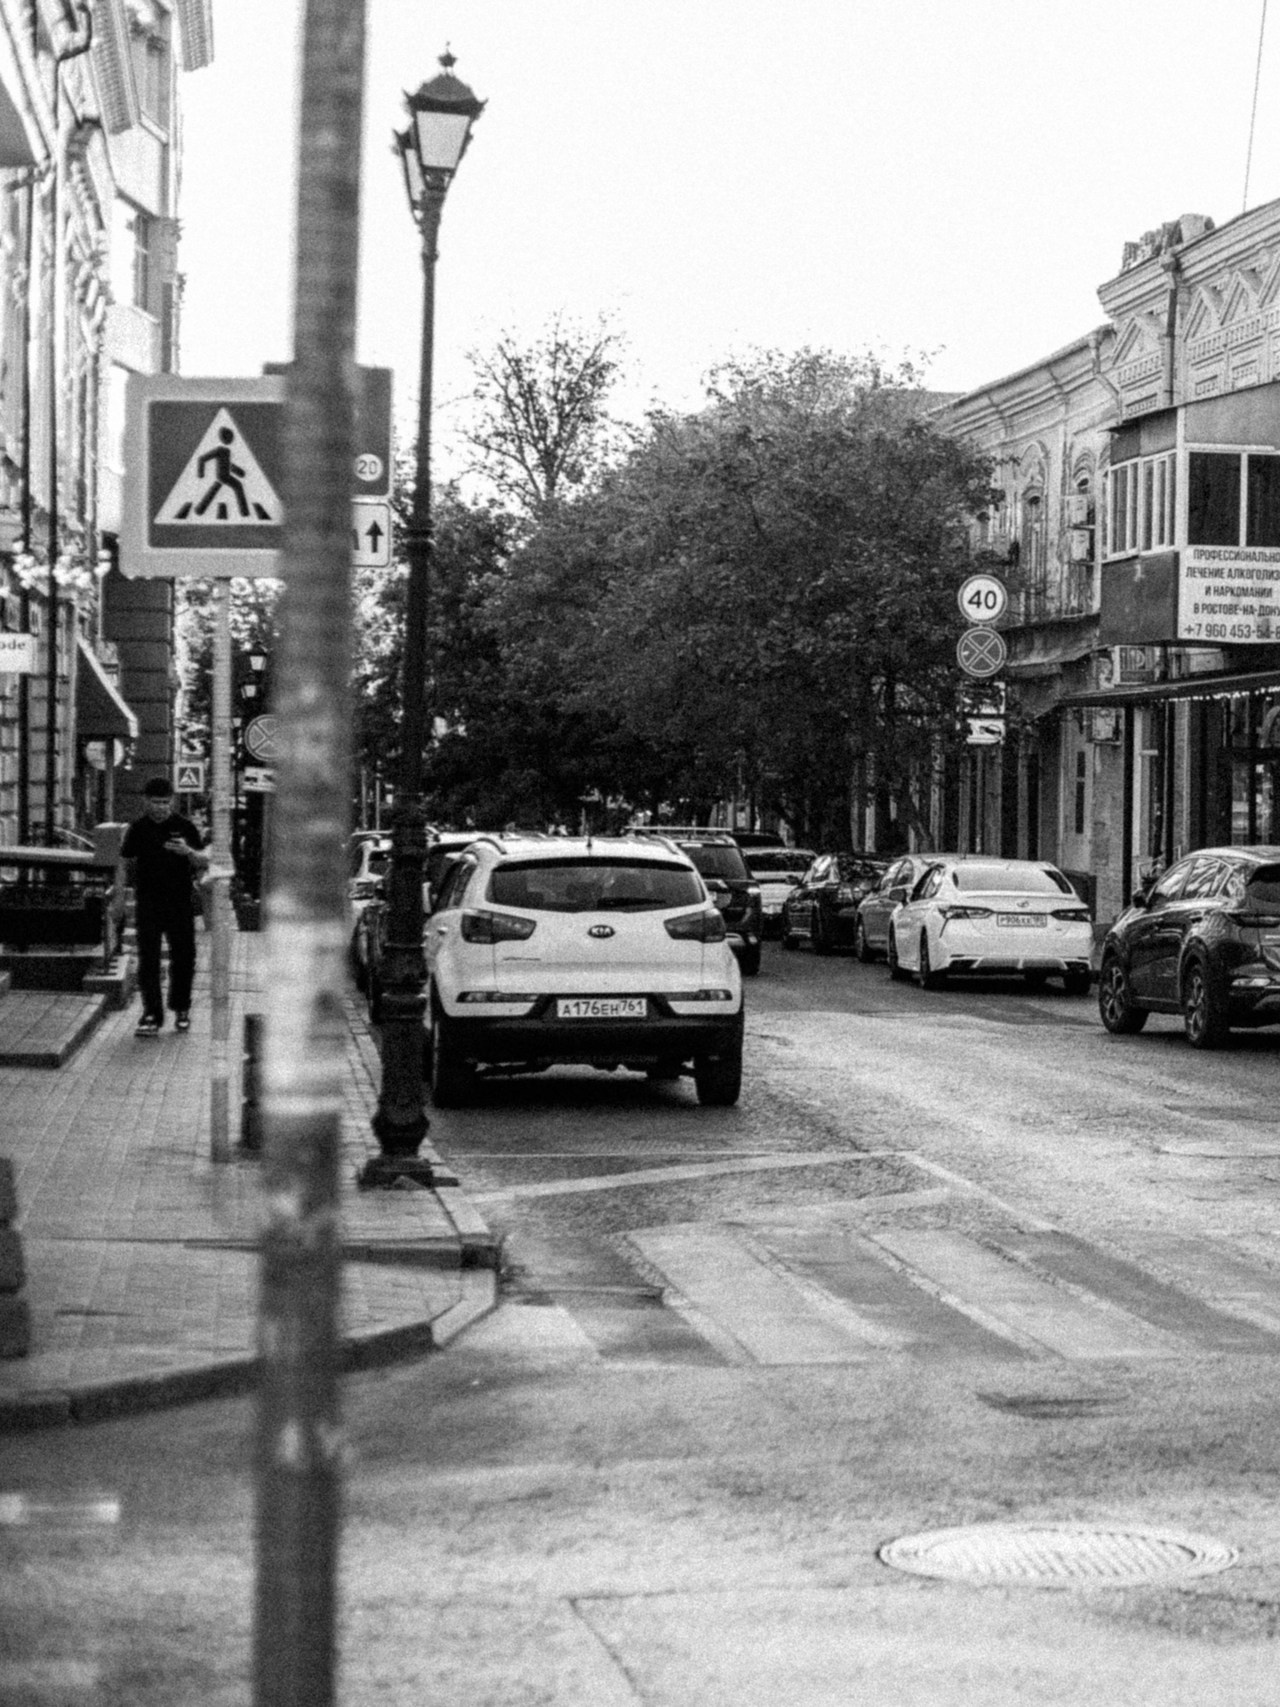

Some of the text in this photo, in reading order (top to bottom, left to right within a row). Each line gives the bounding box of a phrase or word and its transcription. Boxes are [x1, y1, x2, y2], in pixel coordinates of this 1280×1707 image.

[358, 460, 378, 475] 20
[1185, 566, 1226, 579] ЛЕЧЕНИЕ
[1205, 585, 1273, 598] И НАРКОМАНИИ
[967, 590, 997, 610] 40
[1194, 603, 1199, 614] В
[1184, 623, 1202, 636] +7
[1205, 624, 1227, 638] 960
[592, 927, 611, 936] KIA
